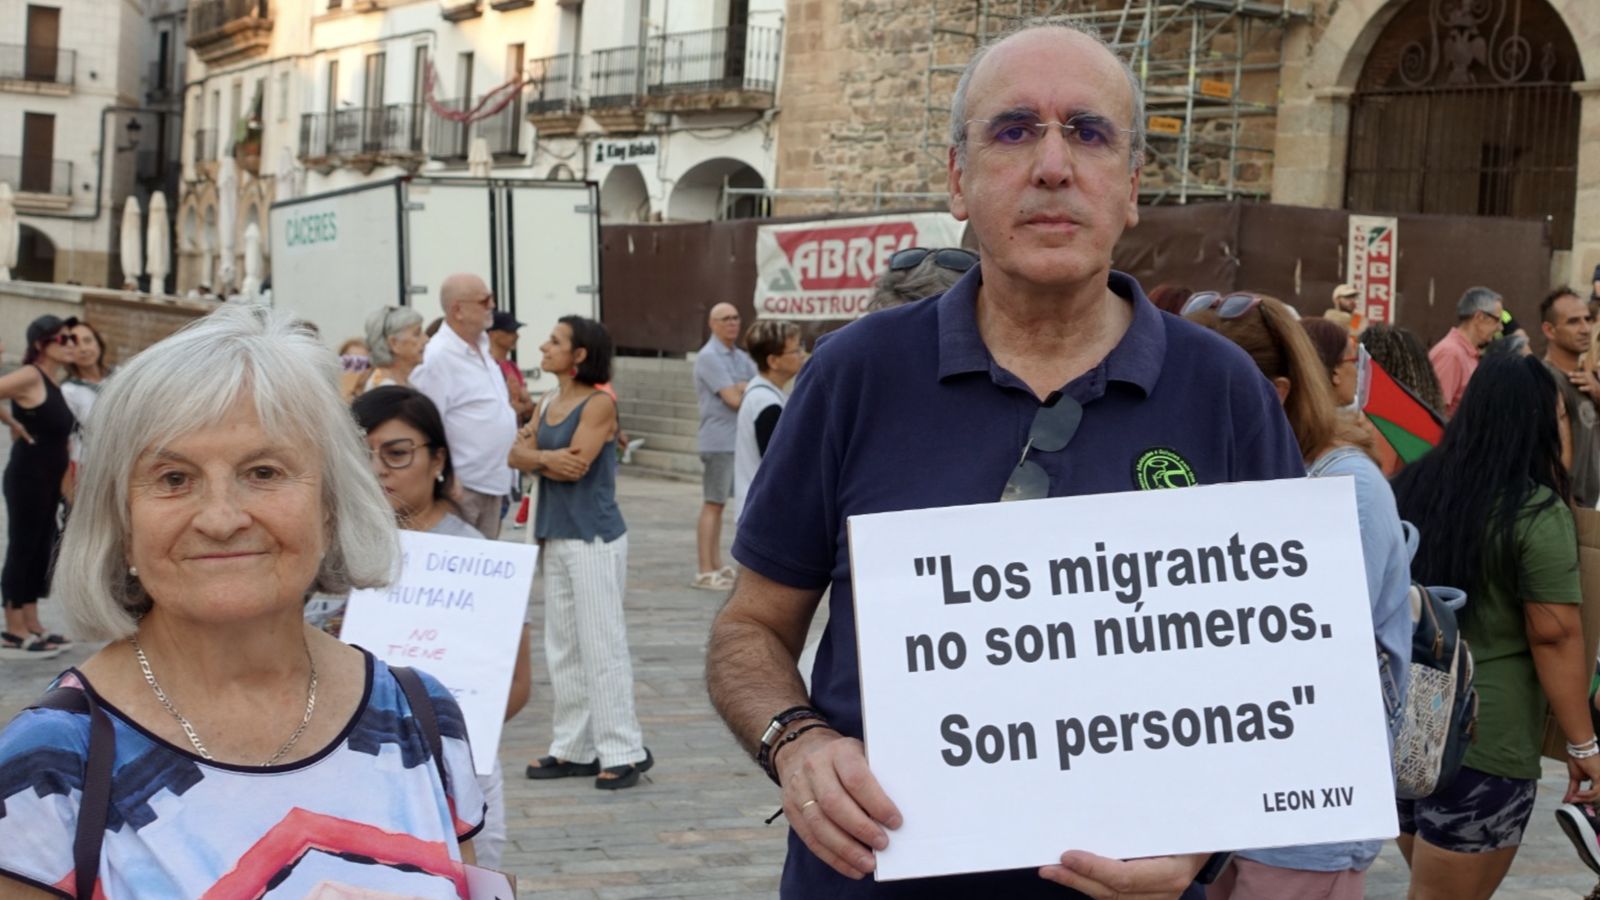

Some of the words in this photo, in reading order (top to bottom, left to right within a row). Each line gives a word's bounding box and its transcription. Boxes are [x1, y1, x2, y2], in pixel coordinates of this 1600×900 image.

[285, 210, 337, 247] CÁCERES
[913, 554, 1031, 605] "Los
[1048, 532, 1308, 604] migrantes
[387, 586, 474, 611] HUMANA
[409, 629, 437, 641] NO
[905, 631, 967, 673] no
[985, 621, 1076, 666] son
[1094, 601, 1332, 657] números.
[940, 713, 1038, 767] Son
[1055, 685, 1315, 771] personas"
[1263, 790, 1316, 813] LEON
[1321, 786, 1354, 808] XIV
